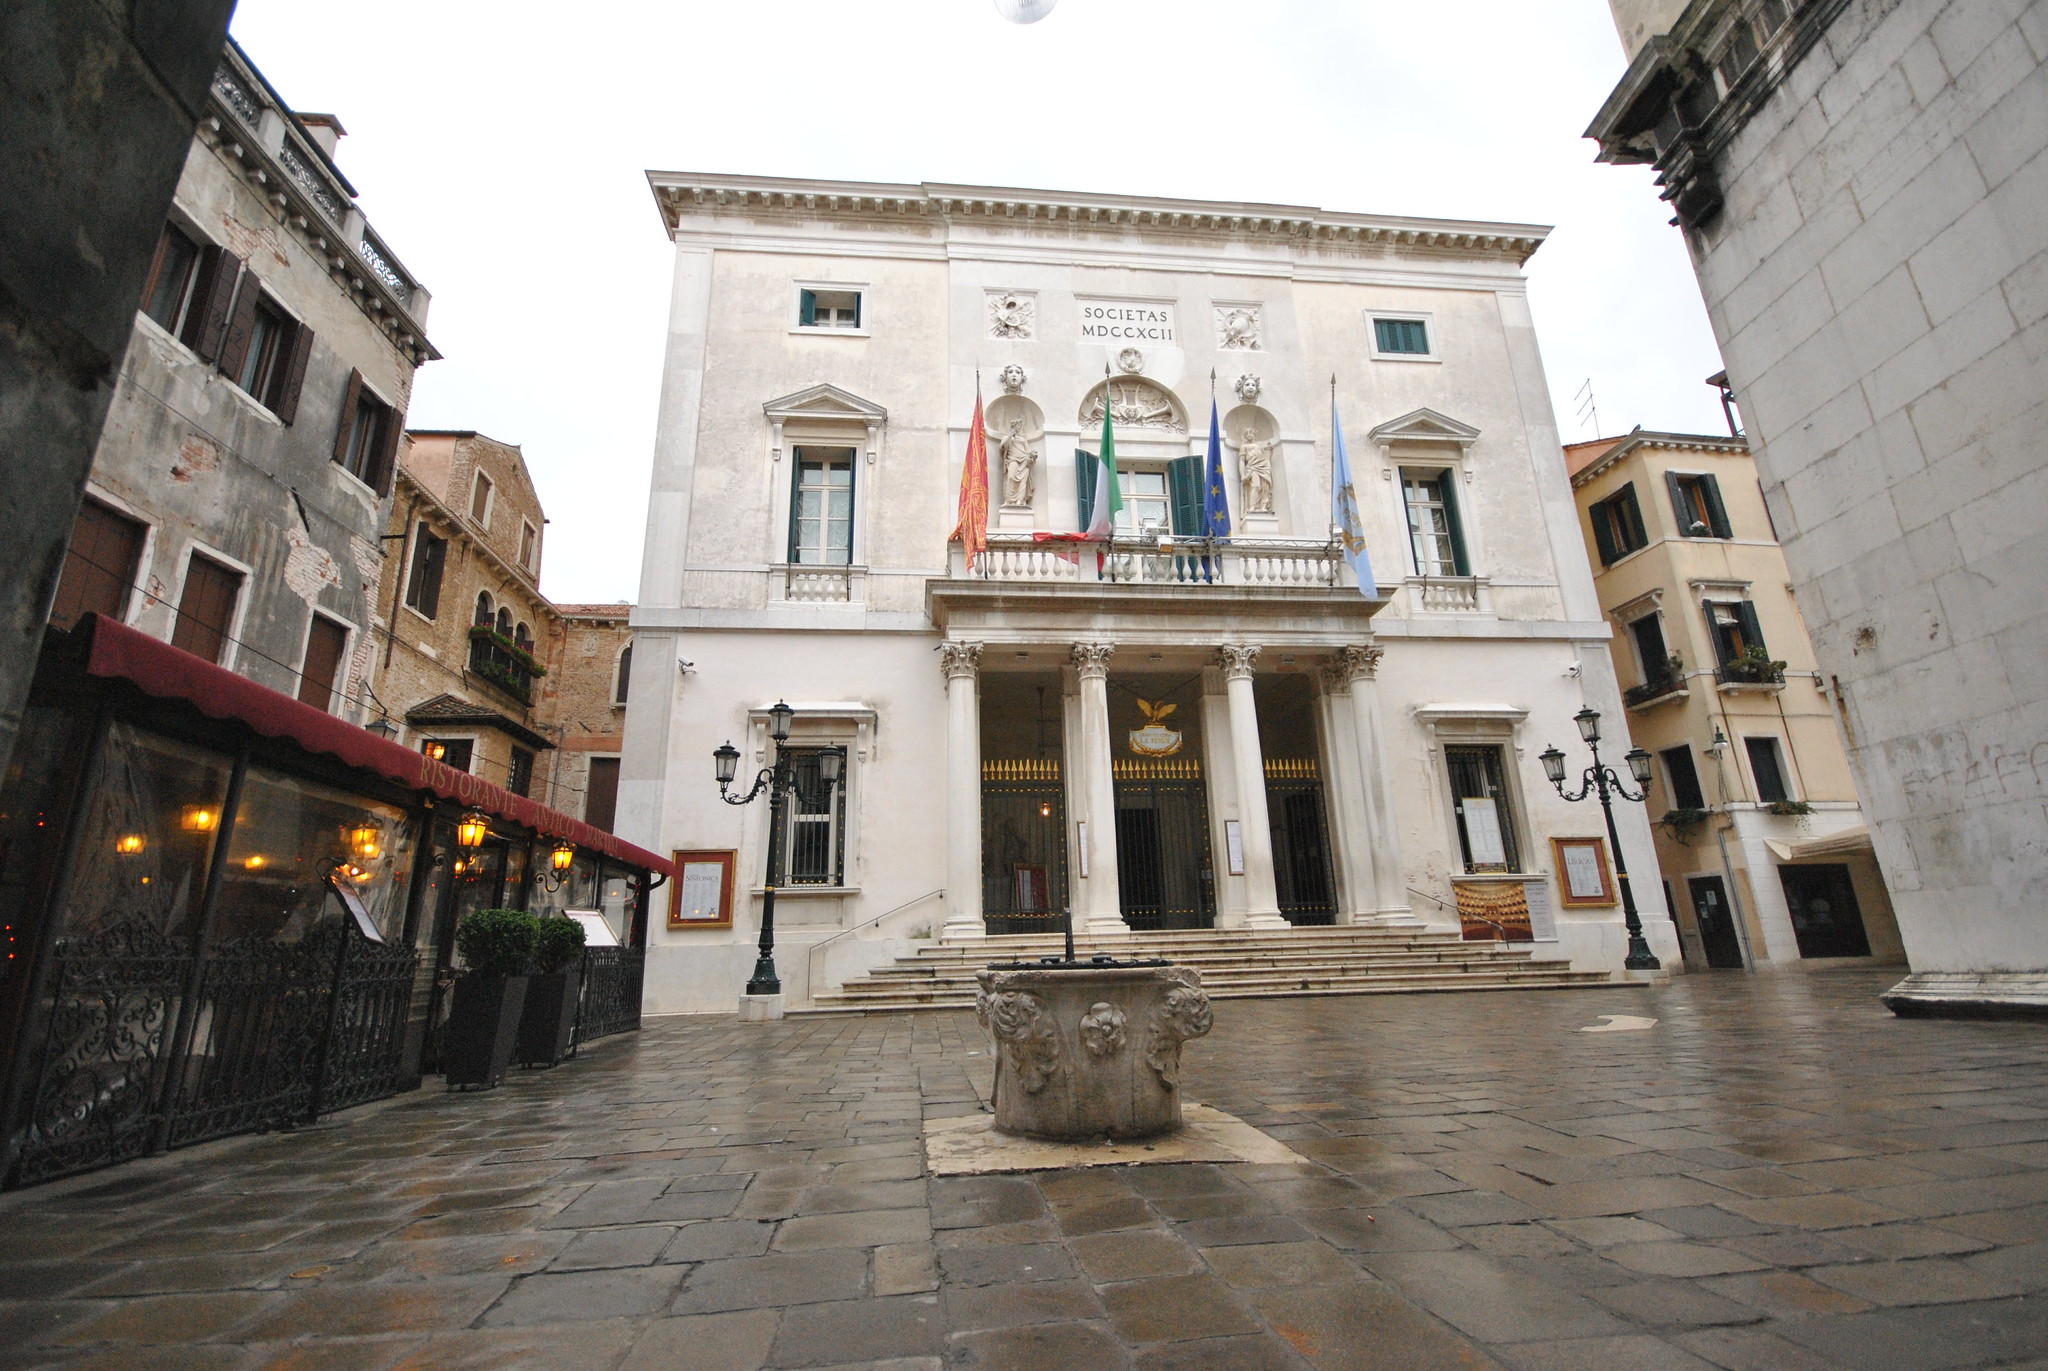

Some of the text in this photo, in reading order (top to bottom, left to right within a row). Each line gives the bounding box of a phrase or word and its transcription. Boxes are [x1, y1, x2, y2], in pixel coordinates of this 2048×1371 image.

[1084, 307, 1168, 322] SOCIETAS
[1082, 324, 1173, 340] MDCCXCII
[420, 757, 517, 816] RISTORANTE
